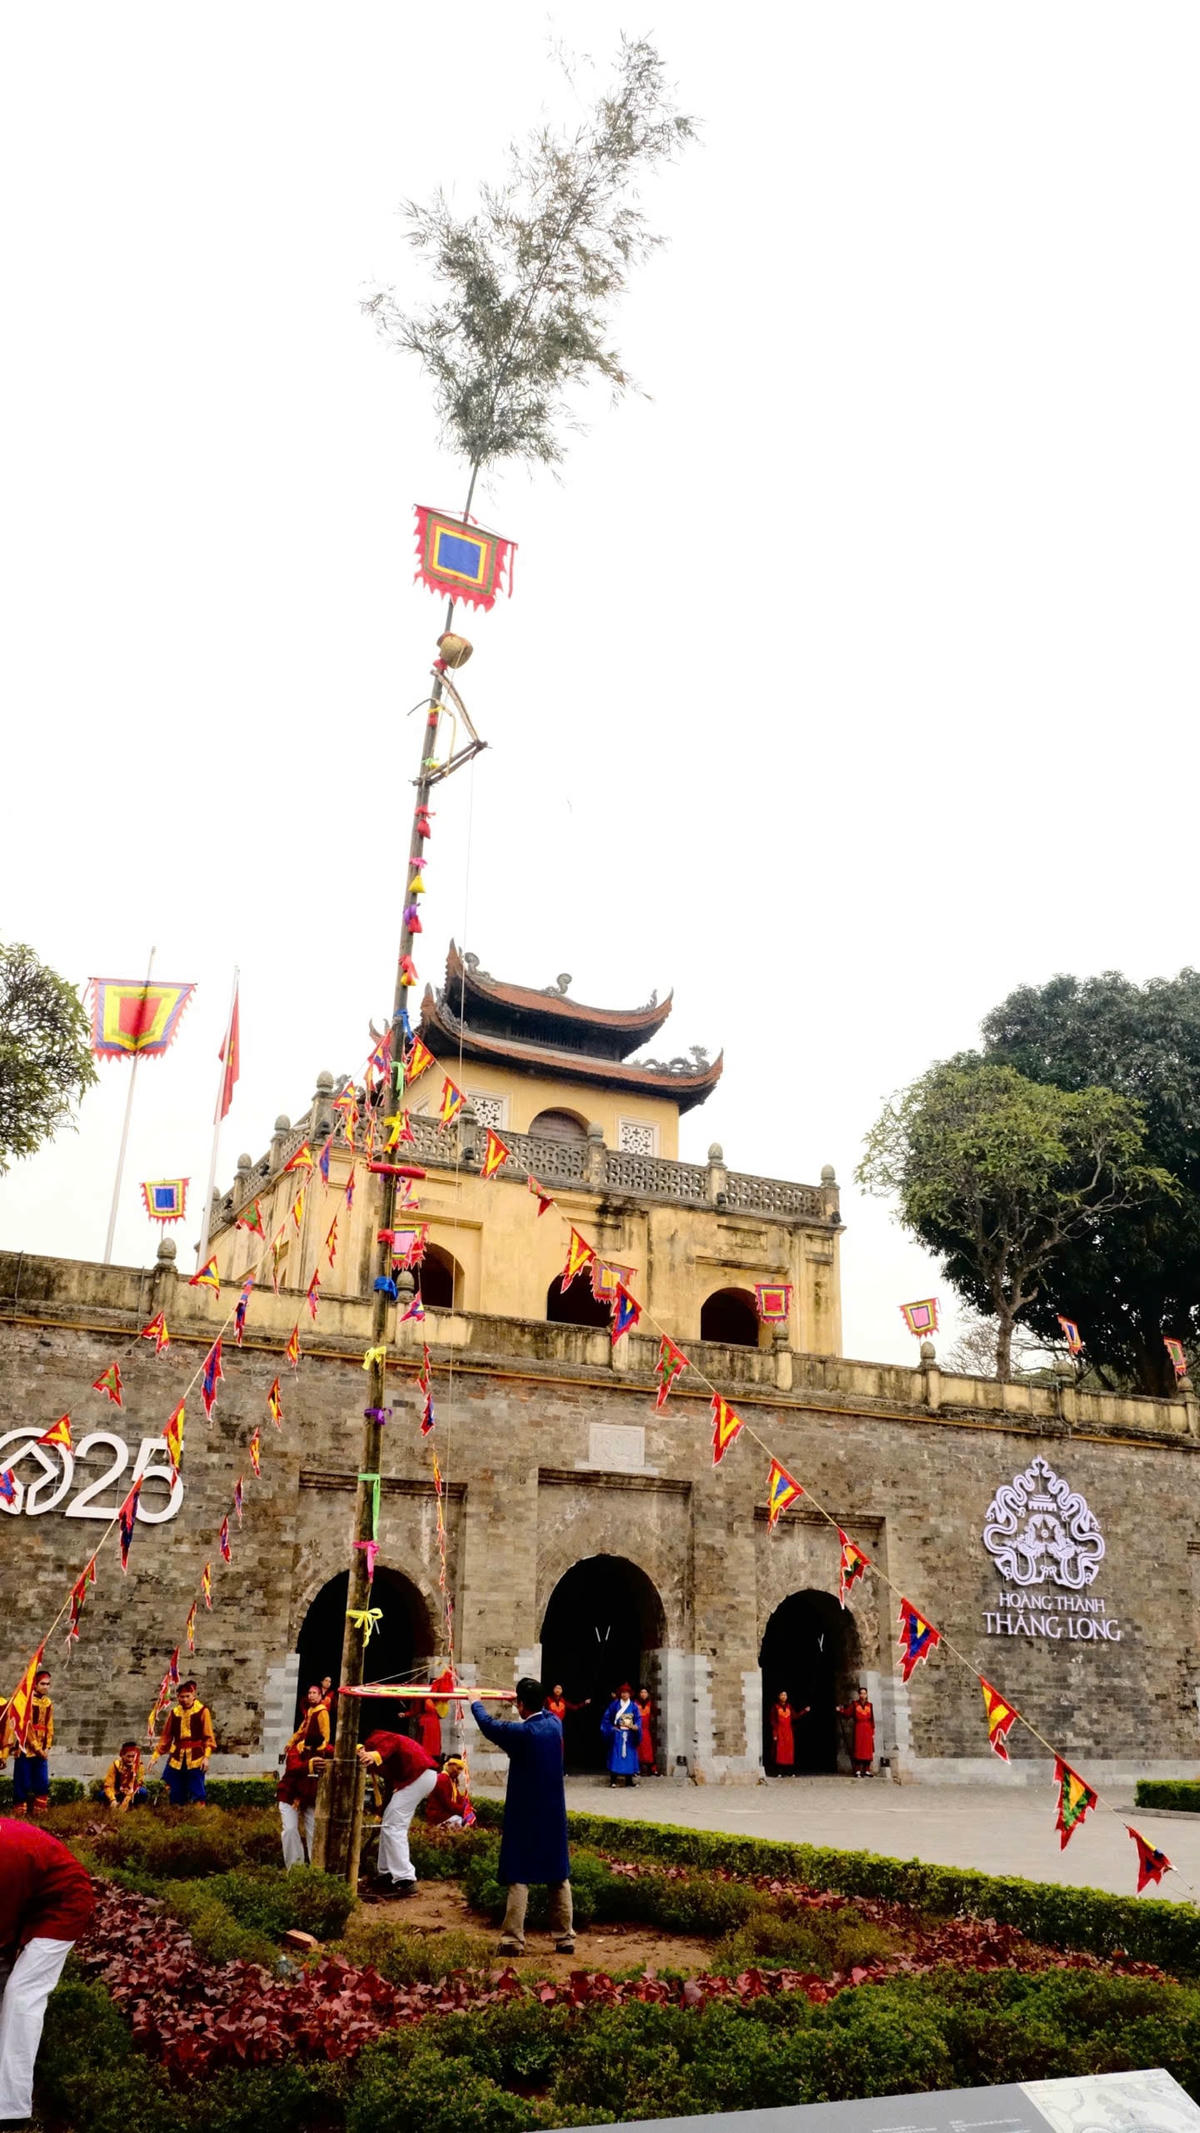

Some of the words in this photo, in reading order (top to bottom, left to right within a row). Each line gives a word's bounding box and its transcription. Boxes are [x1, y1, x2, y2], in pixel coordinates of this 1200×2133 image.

[999, 1591, 1052, 1610] HOÀNG
[1055, 1594, 1105, 1613] THÀNH
[982, 1608, 1062, 1639] THĂNG
[1067, 1617, 1121, 1642] LONG
